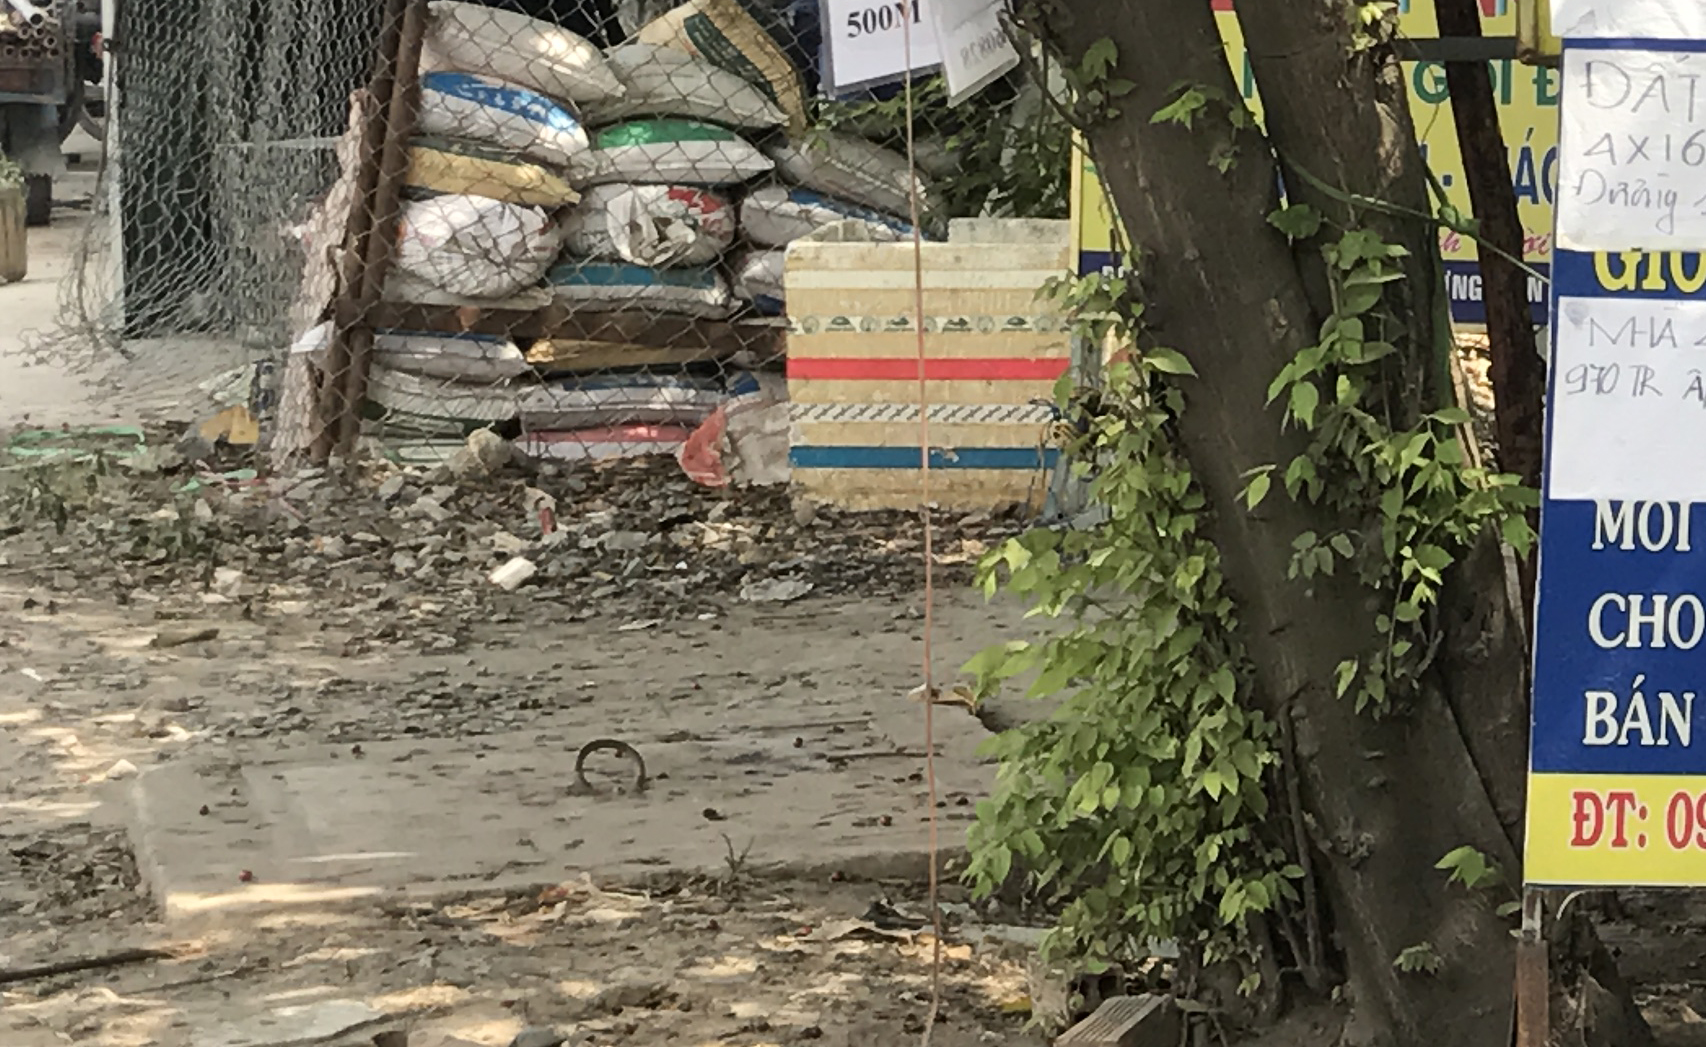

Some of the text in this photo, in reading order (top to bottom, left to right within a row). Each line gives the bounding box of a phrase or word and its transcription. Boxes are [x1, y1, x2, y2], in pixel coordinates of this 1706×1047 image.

[1588, 591, 1706, 651] CHO
[1582, 674, 1695, 749] BÁN
[1570, 790, 1650, 849] ĐT:
